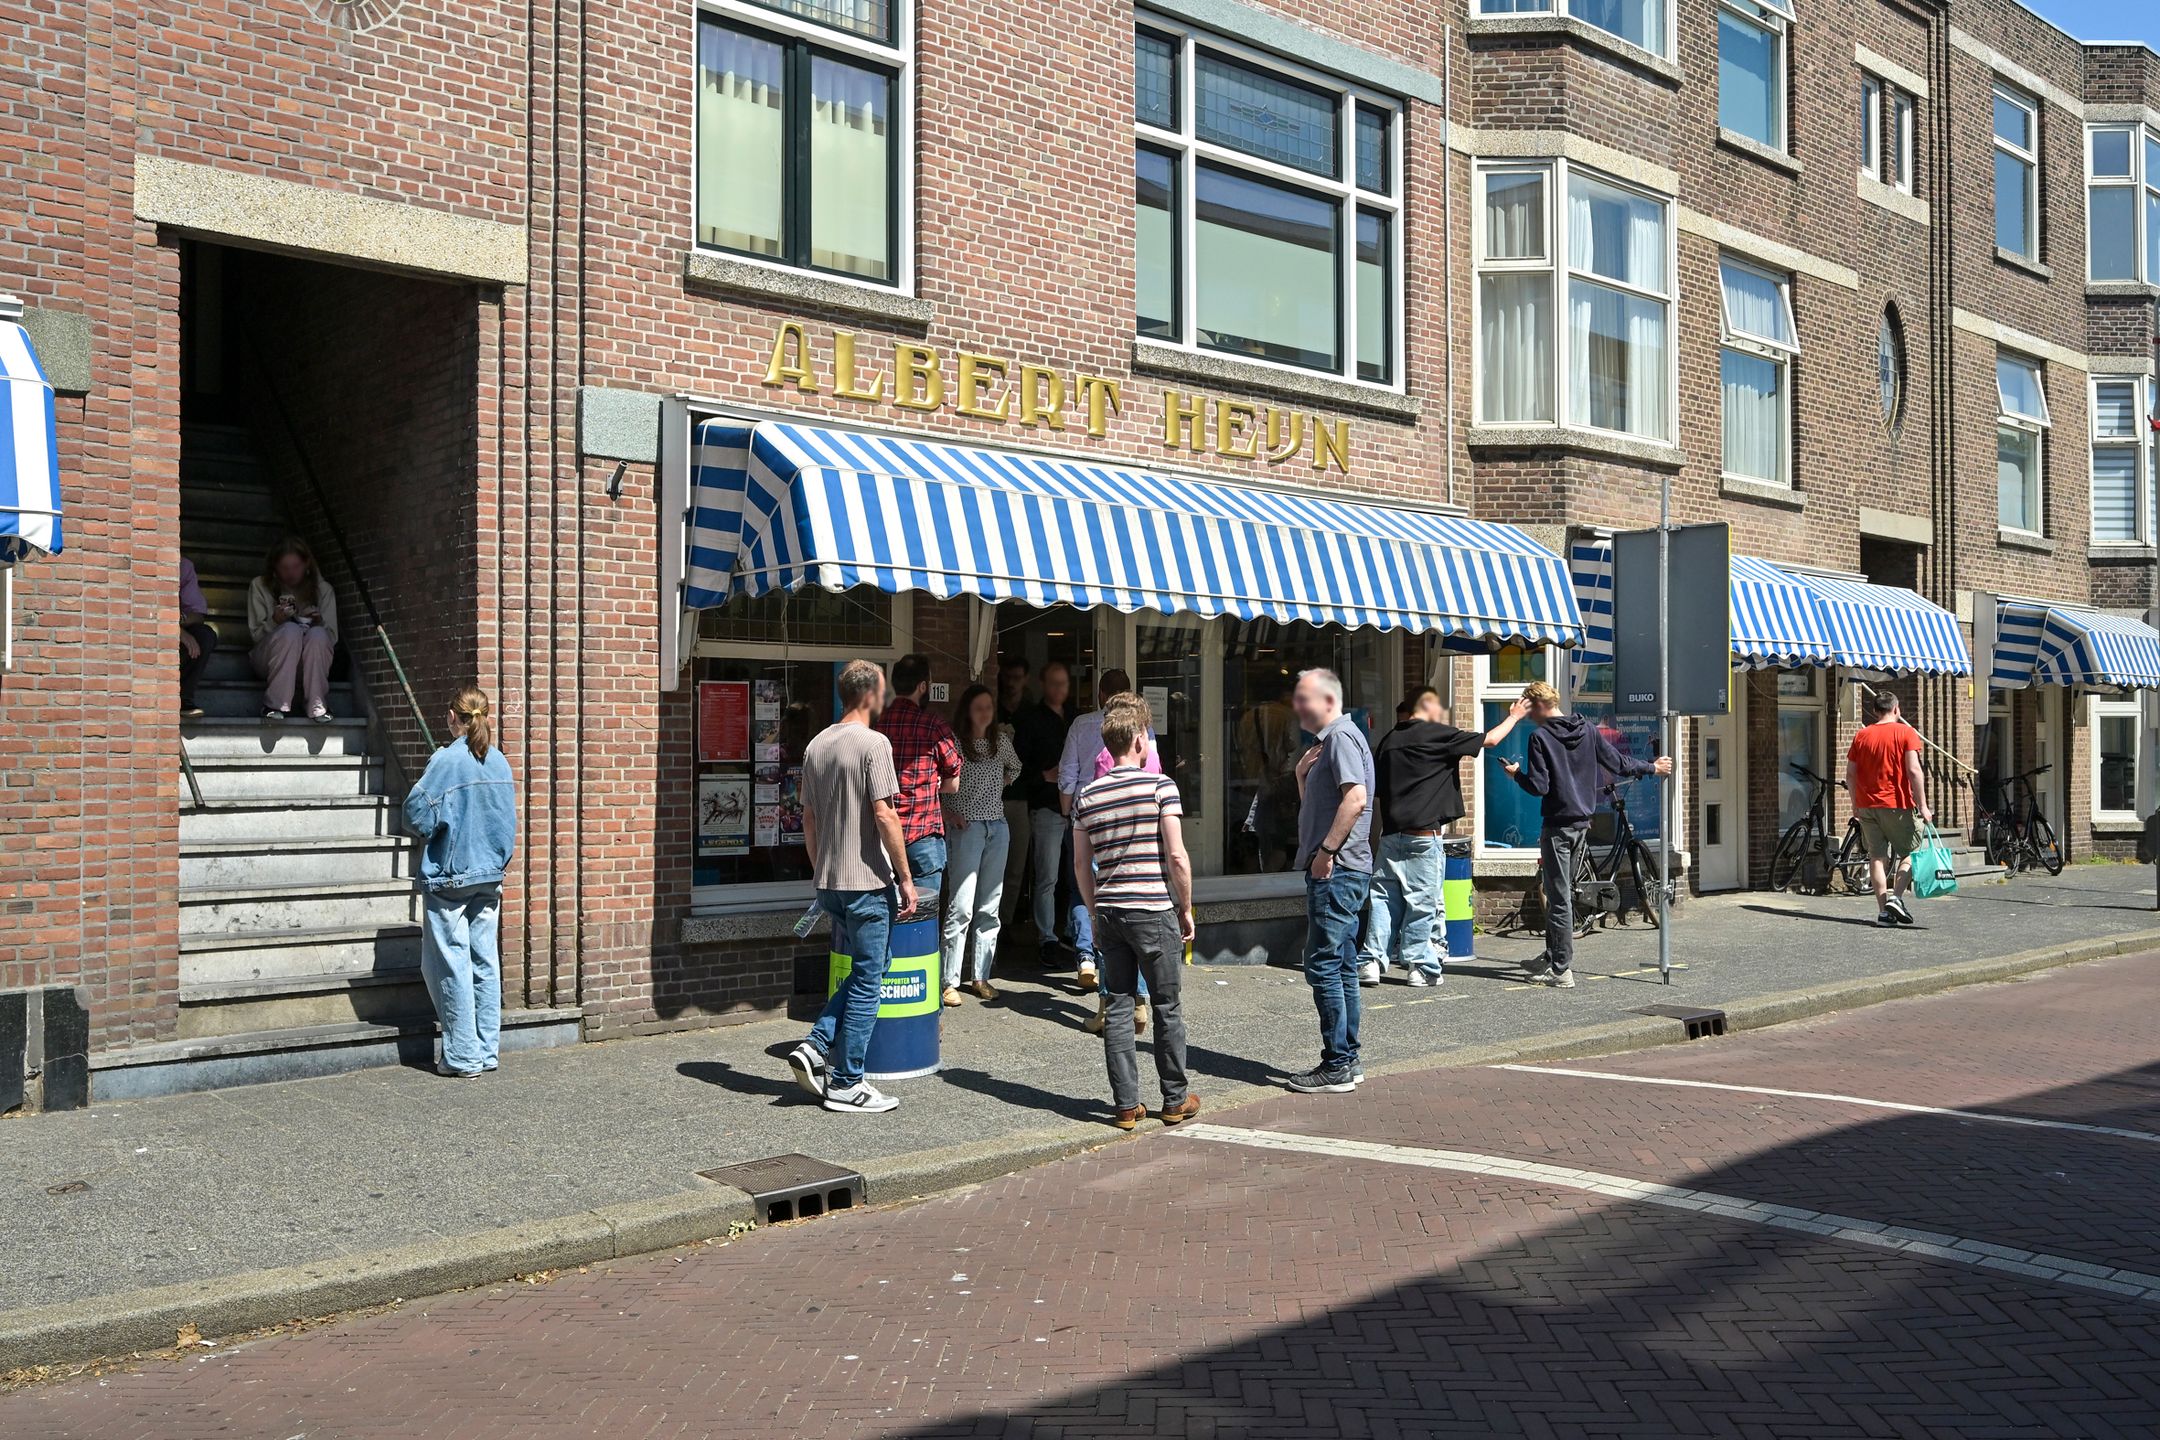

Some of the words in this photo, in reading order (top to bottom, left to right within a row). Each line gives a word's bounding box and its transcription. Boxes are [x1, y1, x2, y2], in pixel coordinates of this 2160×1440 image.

[761, 319, 1122, 439] ALBERT
[1163, 390, 1350, 474] HEIJN
[932, 685, 945, 700] 116
[1628, 693, 1654, 702] BUKO
[881, 977, 910, 985] SUPPORTER
